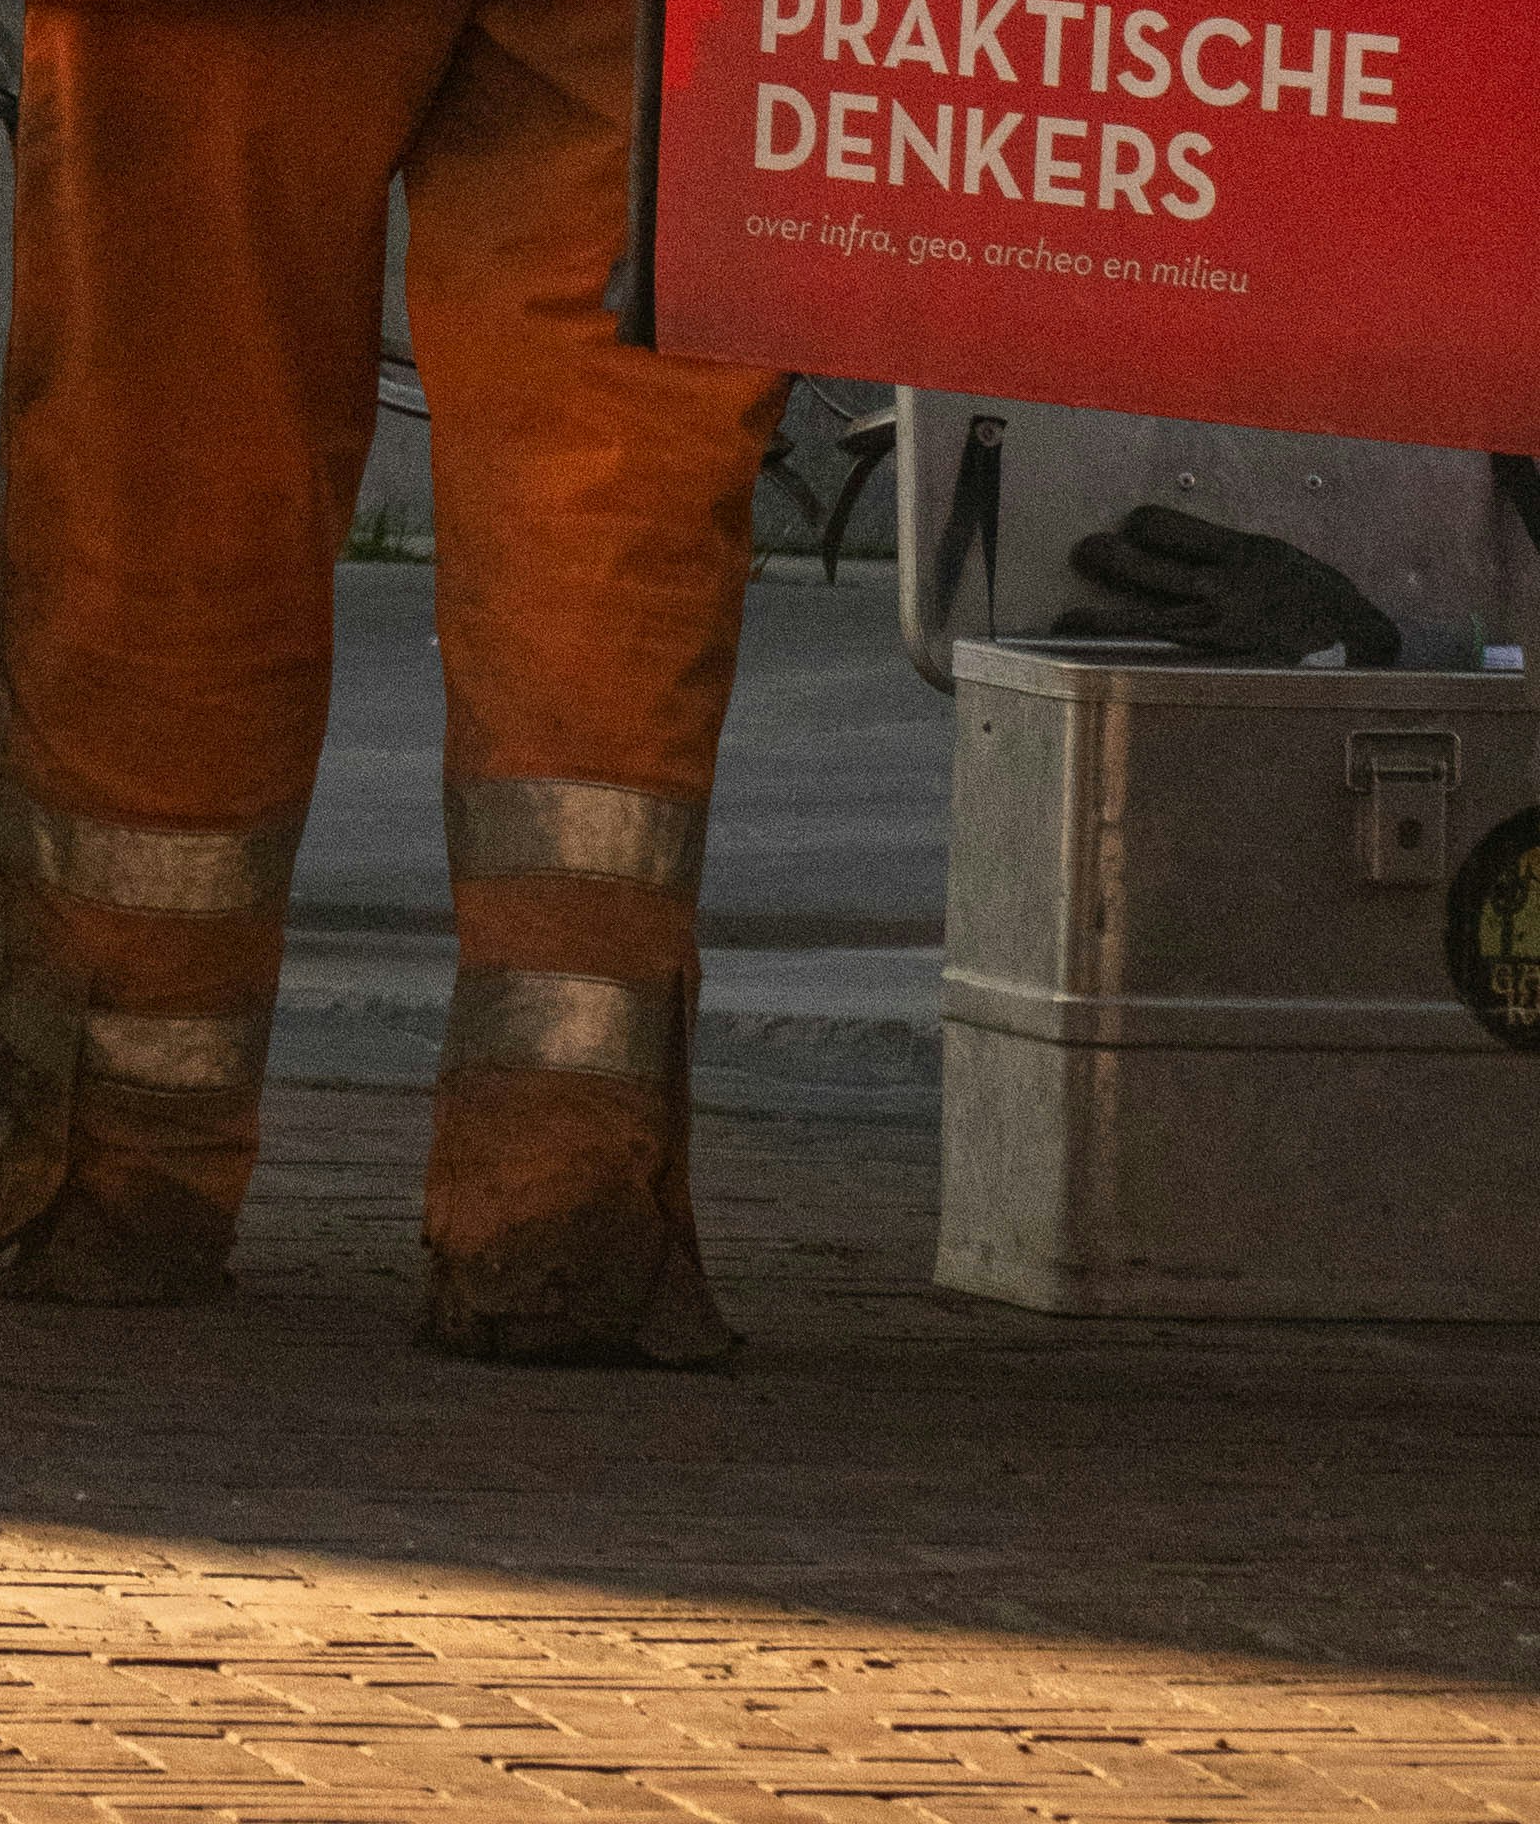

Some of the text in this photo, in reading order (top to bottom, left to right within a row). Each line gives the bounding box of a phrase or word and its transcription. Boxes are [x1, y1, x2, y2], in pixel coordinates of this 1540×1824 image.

[753, 81, 1218, 222] DENKERS
[746, 213, 1249, 294] over infra, geo, archeo en milieu
